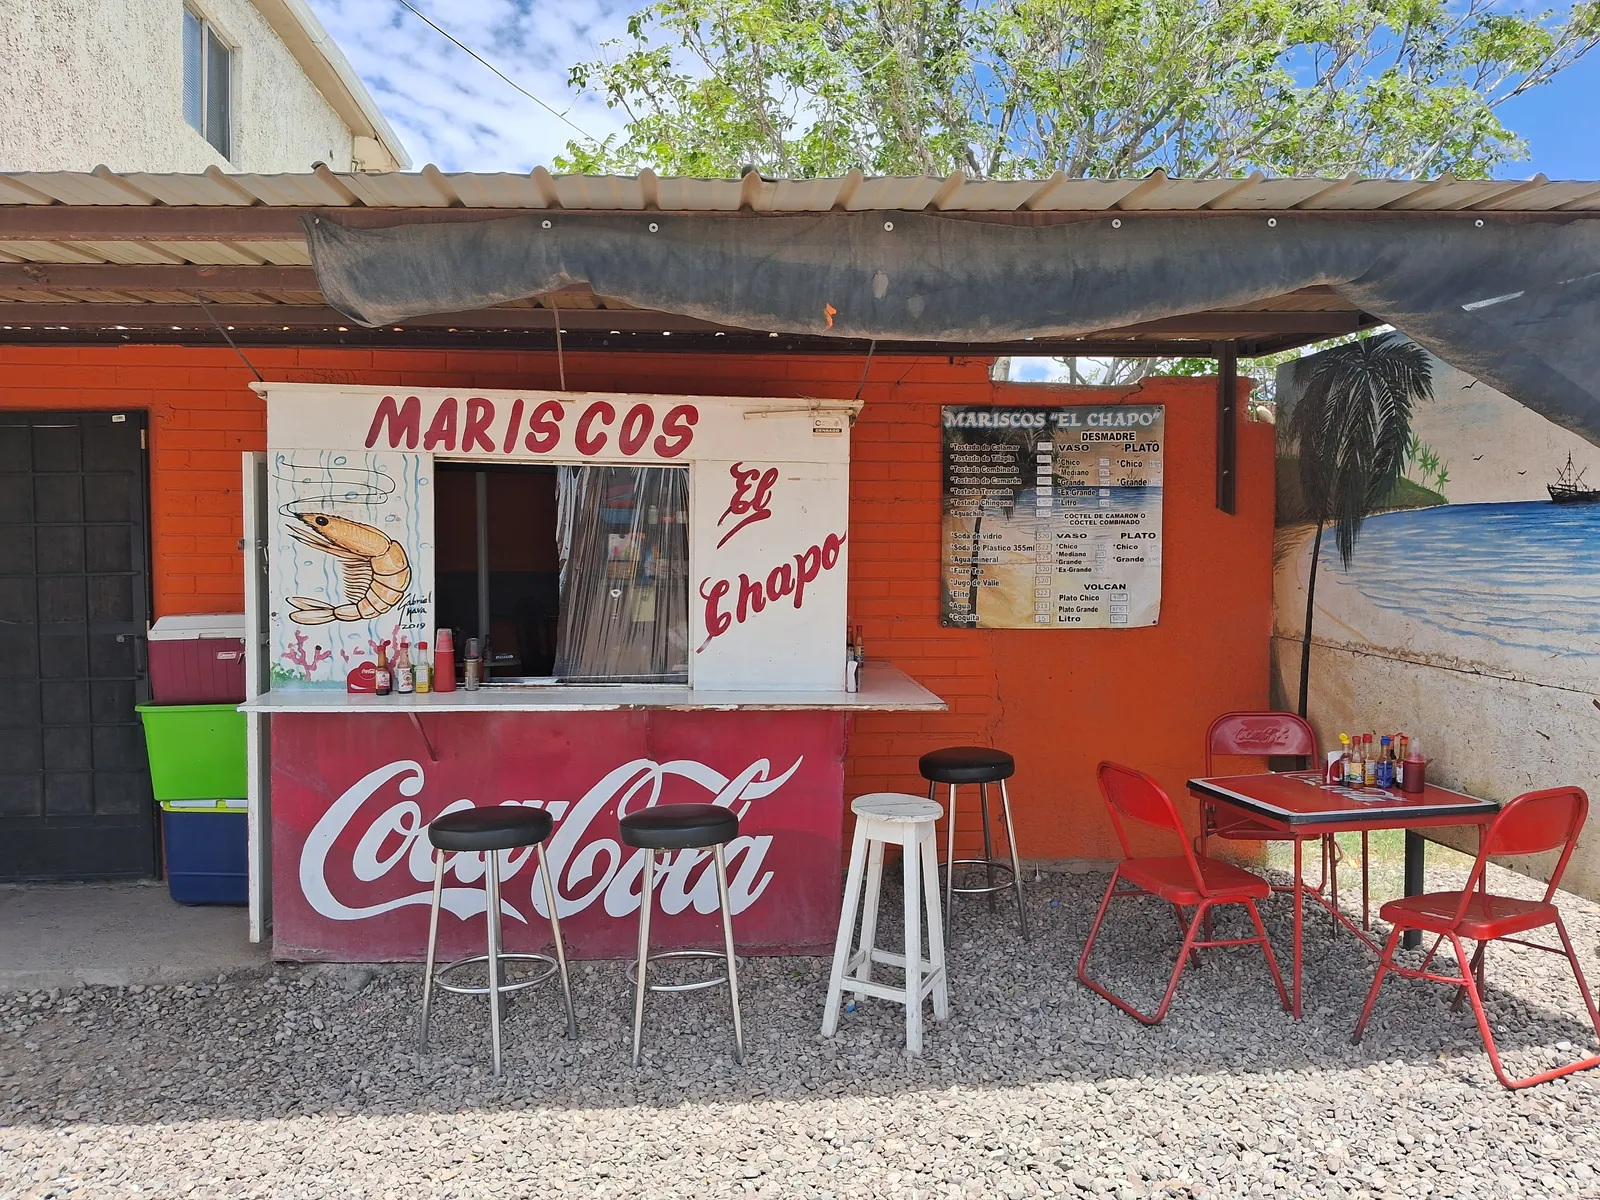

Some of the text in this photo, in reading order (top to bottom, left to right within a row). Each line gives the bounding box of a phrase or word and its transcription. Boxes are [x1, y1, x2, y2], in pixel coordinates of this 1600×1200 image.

[944, 411, 1046, 427] MARISCOS
[364, 395, 700, 458] MARISCOS
[1082, 432, 1136, 441] DESMADRE
[953, 443, 980, 451] Tostada
[981, 443, 990, 451] de
[1058, 444, 1090, 452] VASO
[1124, 443, 1160, 452] PLATO
[953, 454, 980, 462] Tostada
[1120, 459, 1143, 468] Chico
[953, 465, 1019, 473] Tostada Combinada
[953, 476, 980, 484] Tostada
[1120, 478, 1147, 486] Grande
[953, 487, 980, 495] Tostada
[717, 461, 779, 530] El
[953, 556, 970, 564] Agua
[953, 580, 970, 588] Jugo
[696, 530, 847, 654] Chapo
[953, 590, 969, 598] Elite
[953, 602, 970, 610] Agua
[952, 613, 979, 622] Coquita
[401, 622, 426, 630] 2019
